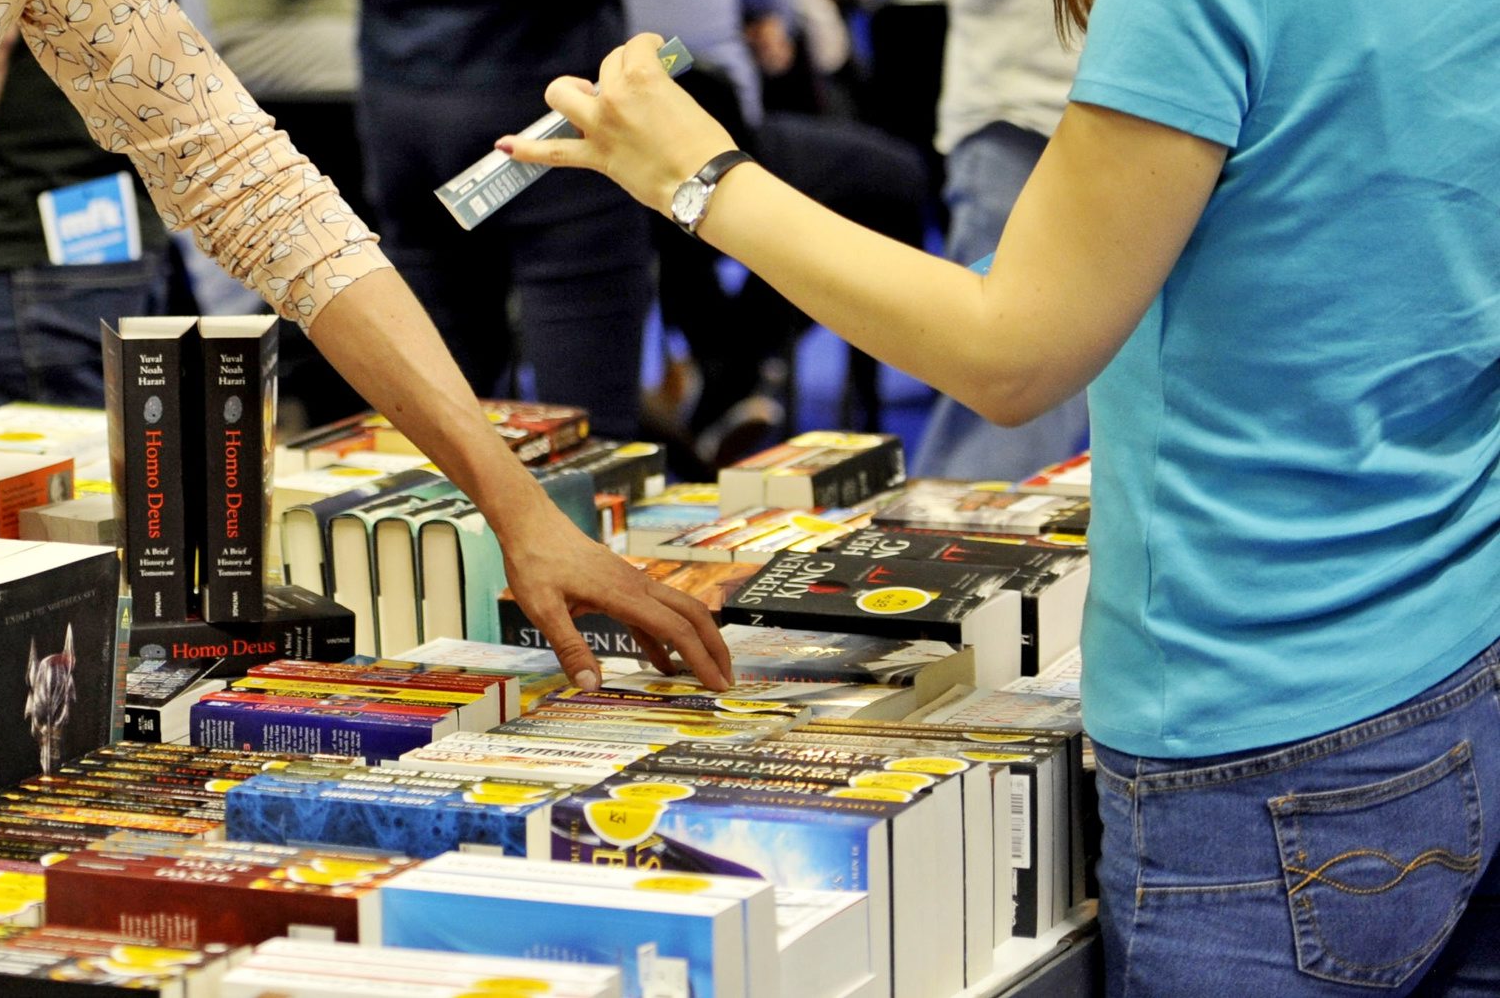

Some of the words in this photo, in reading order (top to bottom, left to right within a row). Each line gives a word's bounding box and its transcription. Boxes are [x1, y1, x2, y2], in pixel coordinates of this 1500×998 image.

[139, 354, 162, 364] Yuval
[220, 354, 243, 364] Yuval
[140, 365, 163, 375] Noah
[220, 365, 243, 375] Noah
[138, 376, 165, 386] Harari
[218, 376, 246, 386] Harari
[145, 430, 162, 490] Homo
[225, 430, 241, 489] Homo
[148, 494, 164, 539] Deus
[227, 494, 242, 538] Deus
[153, 547, 169, 556] Brief
[231, 547, 248, 556] Brief
[139, 558, 163, 568] History
[165, 558, 174, 566] of
[218, 558, 241, 568] History
[243, 558, 252, 566] of
[140, 569, 174, 577] Tomorrow
[218, 568, 251, 577] Tomorrow
[738, 553, 811, 604] STEPHEN
[772, 562, 835, 599] KING
[519, 628, 610, 651] STEN
[172, 642, 228, 659] Homo
[231, 640, 276, 656] Deus
[510, 747, 619, 760] AFTERMATH
[690, 742, 787, 756] COURT
[657, 755, 748, 769] COURT
[757, 760, 849, 777] WINGS
